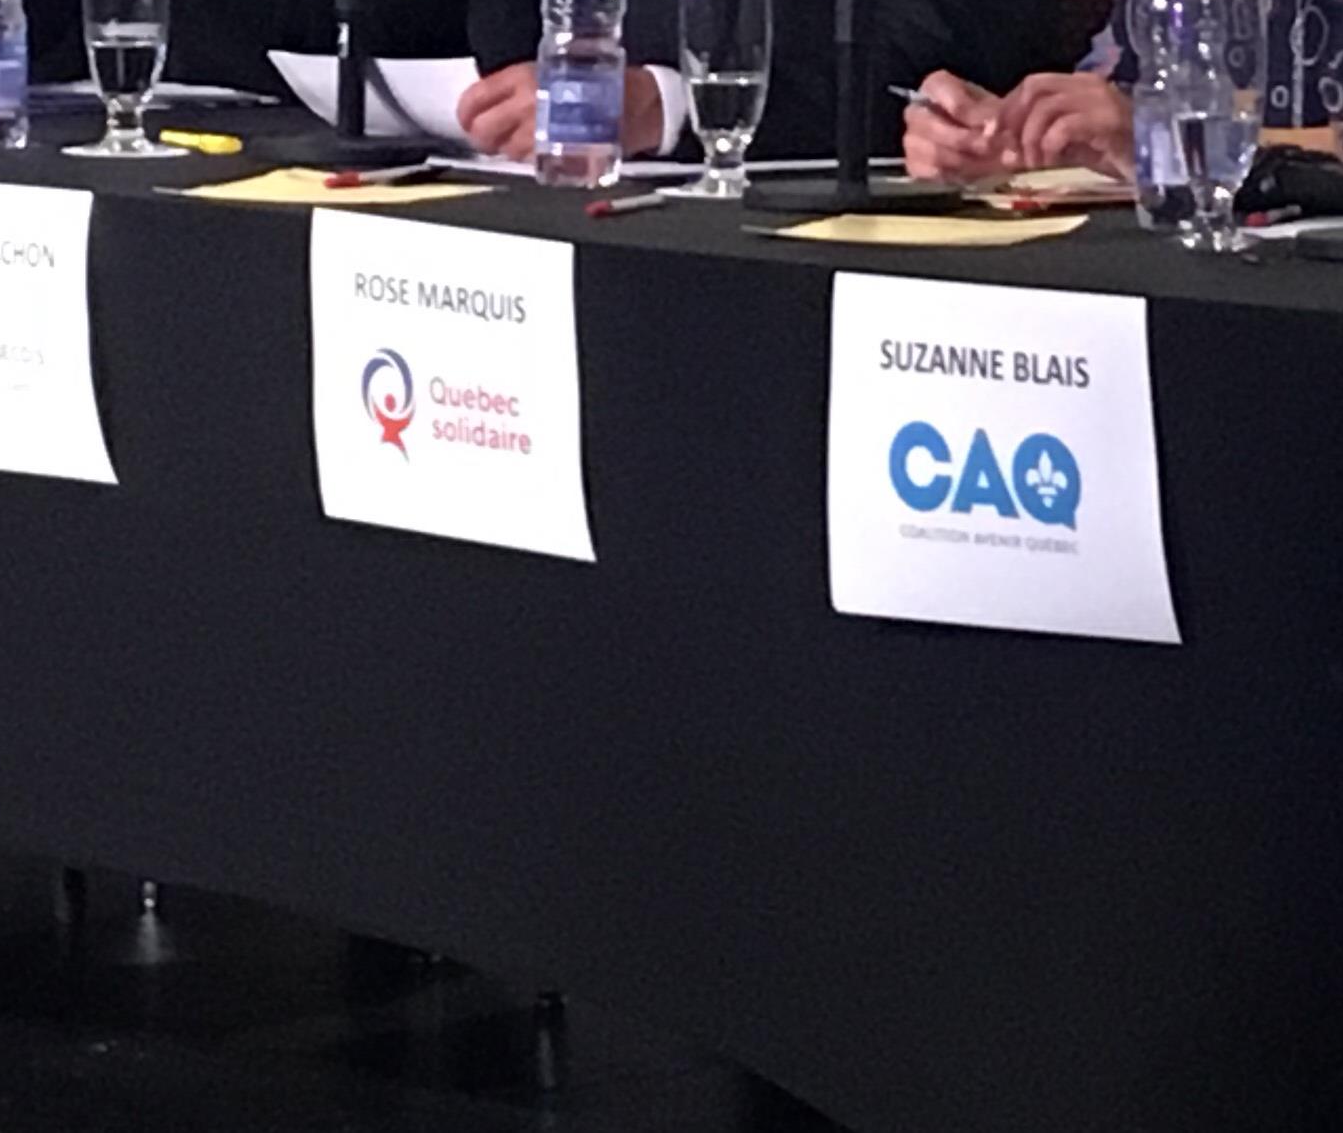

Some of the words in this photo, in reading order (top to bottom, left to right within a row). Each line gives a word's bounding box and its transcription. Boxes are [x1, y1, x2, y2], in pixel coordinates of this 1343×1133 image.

[355, 273, 410, 306] ROSE
[418, 281, 527, 324] MARQUIS
[880, 338, 1004, 381] SUZANNE
[1013, 351, 1091, 389] BLAIS
[432, 417, 532, 455] solidaire
[888, 420, 1082, 532] CAQ
